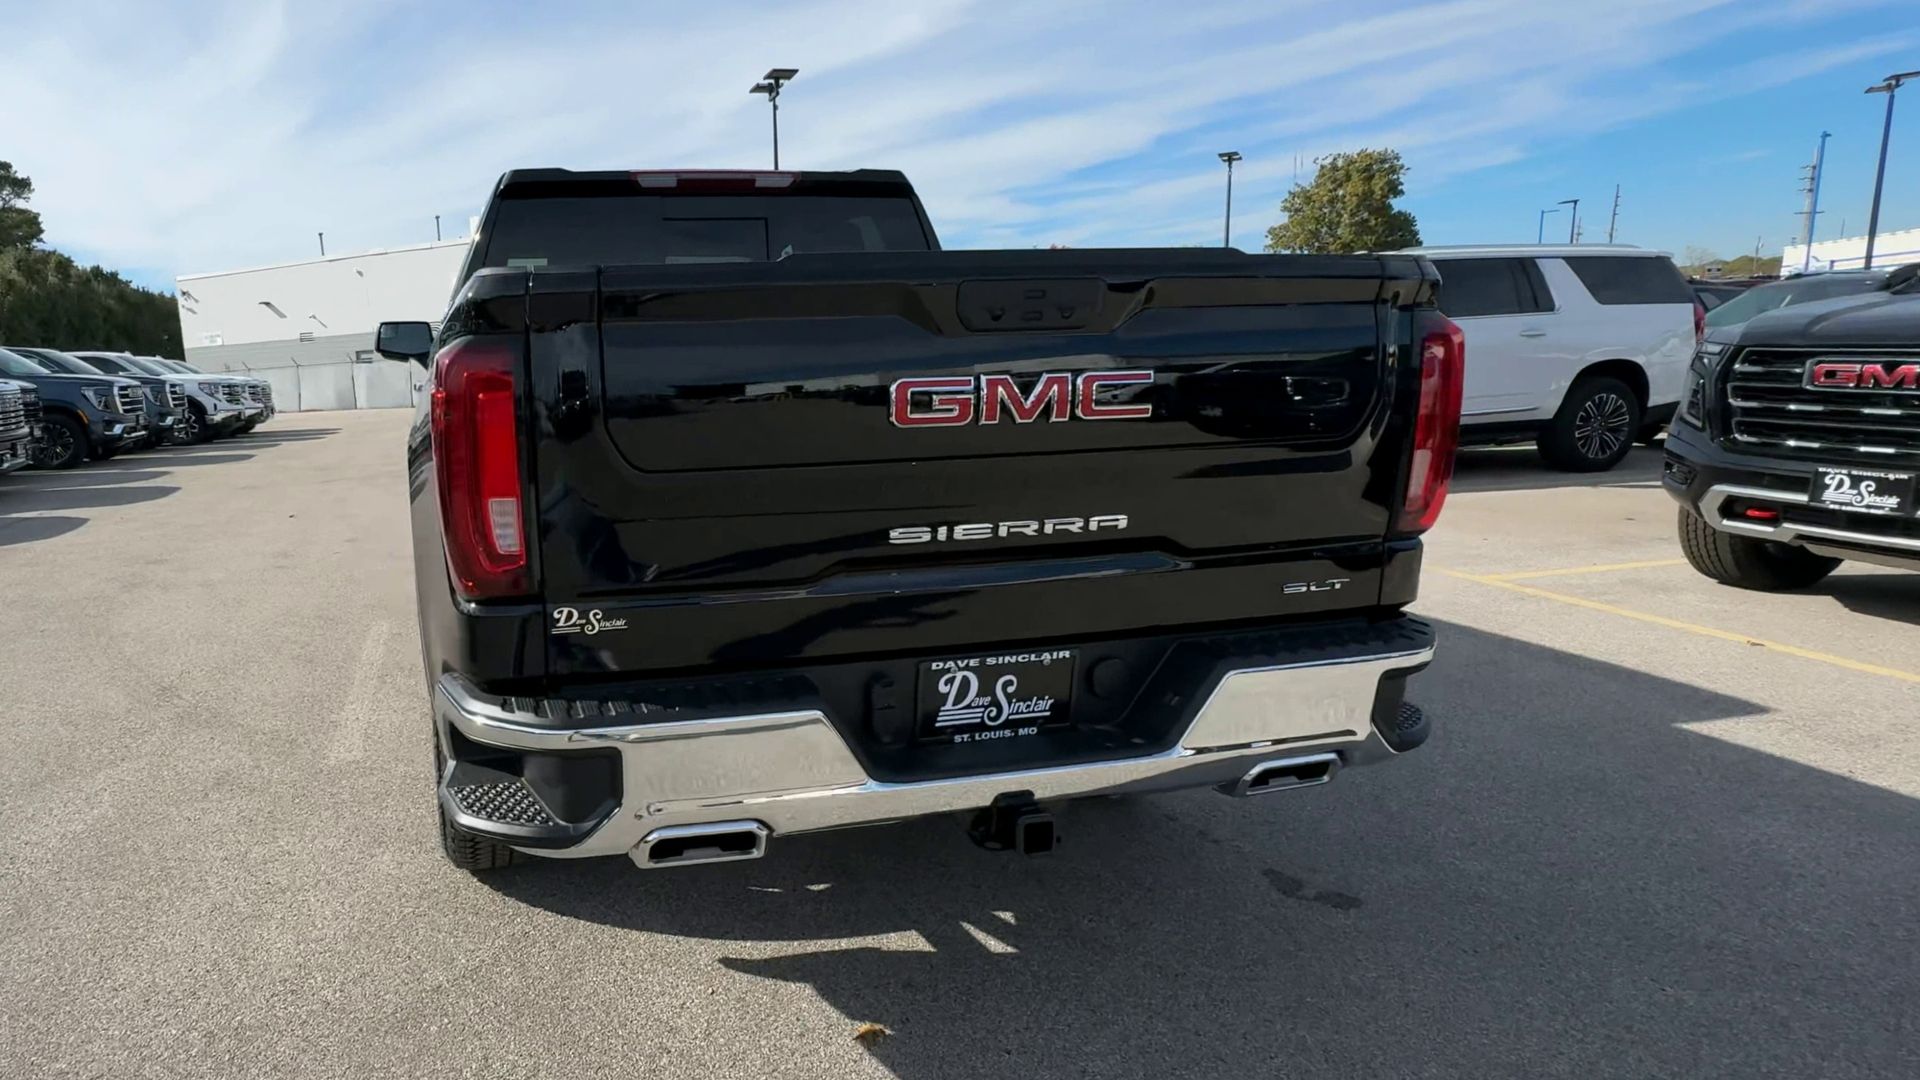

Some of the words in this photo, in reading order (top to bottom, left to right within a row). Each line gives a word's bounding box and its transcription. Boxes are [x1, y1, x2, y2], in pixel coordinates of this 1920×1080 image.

[1814, 364, 1920, 387] GM
[889, 370, 1154, 428] GMC
[889, 514, 1128, 544] SIERRA
[1283, 578, 1350, 593] SLT
[584, 609, 627, 635] Sinclair
[931, 658, 980, 671] DAVE
[986, 650, 1071, 666] SINCLAIR
[938, 670, 992, 711] Dave
[984, 674, 1055, 726] Sinclair
[953, 734, 972, 743] ST.
[1018, 726, 1038, 736] MO
